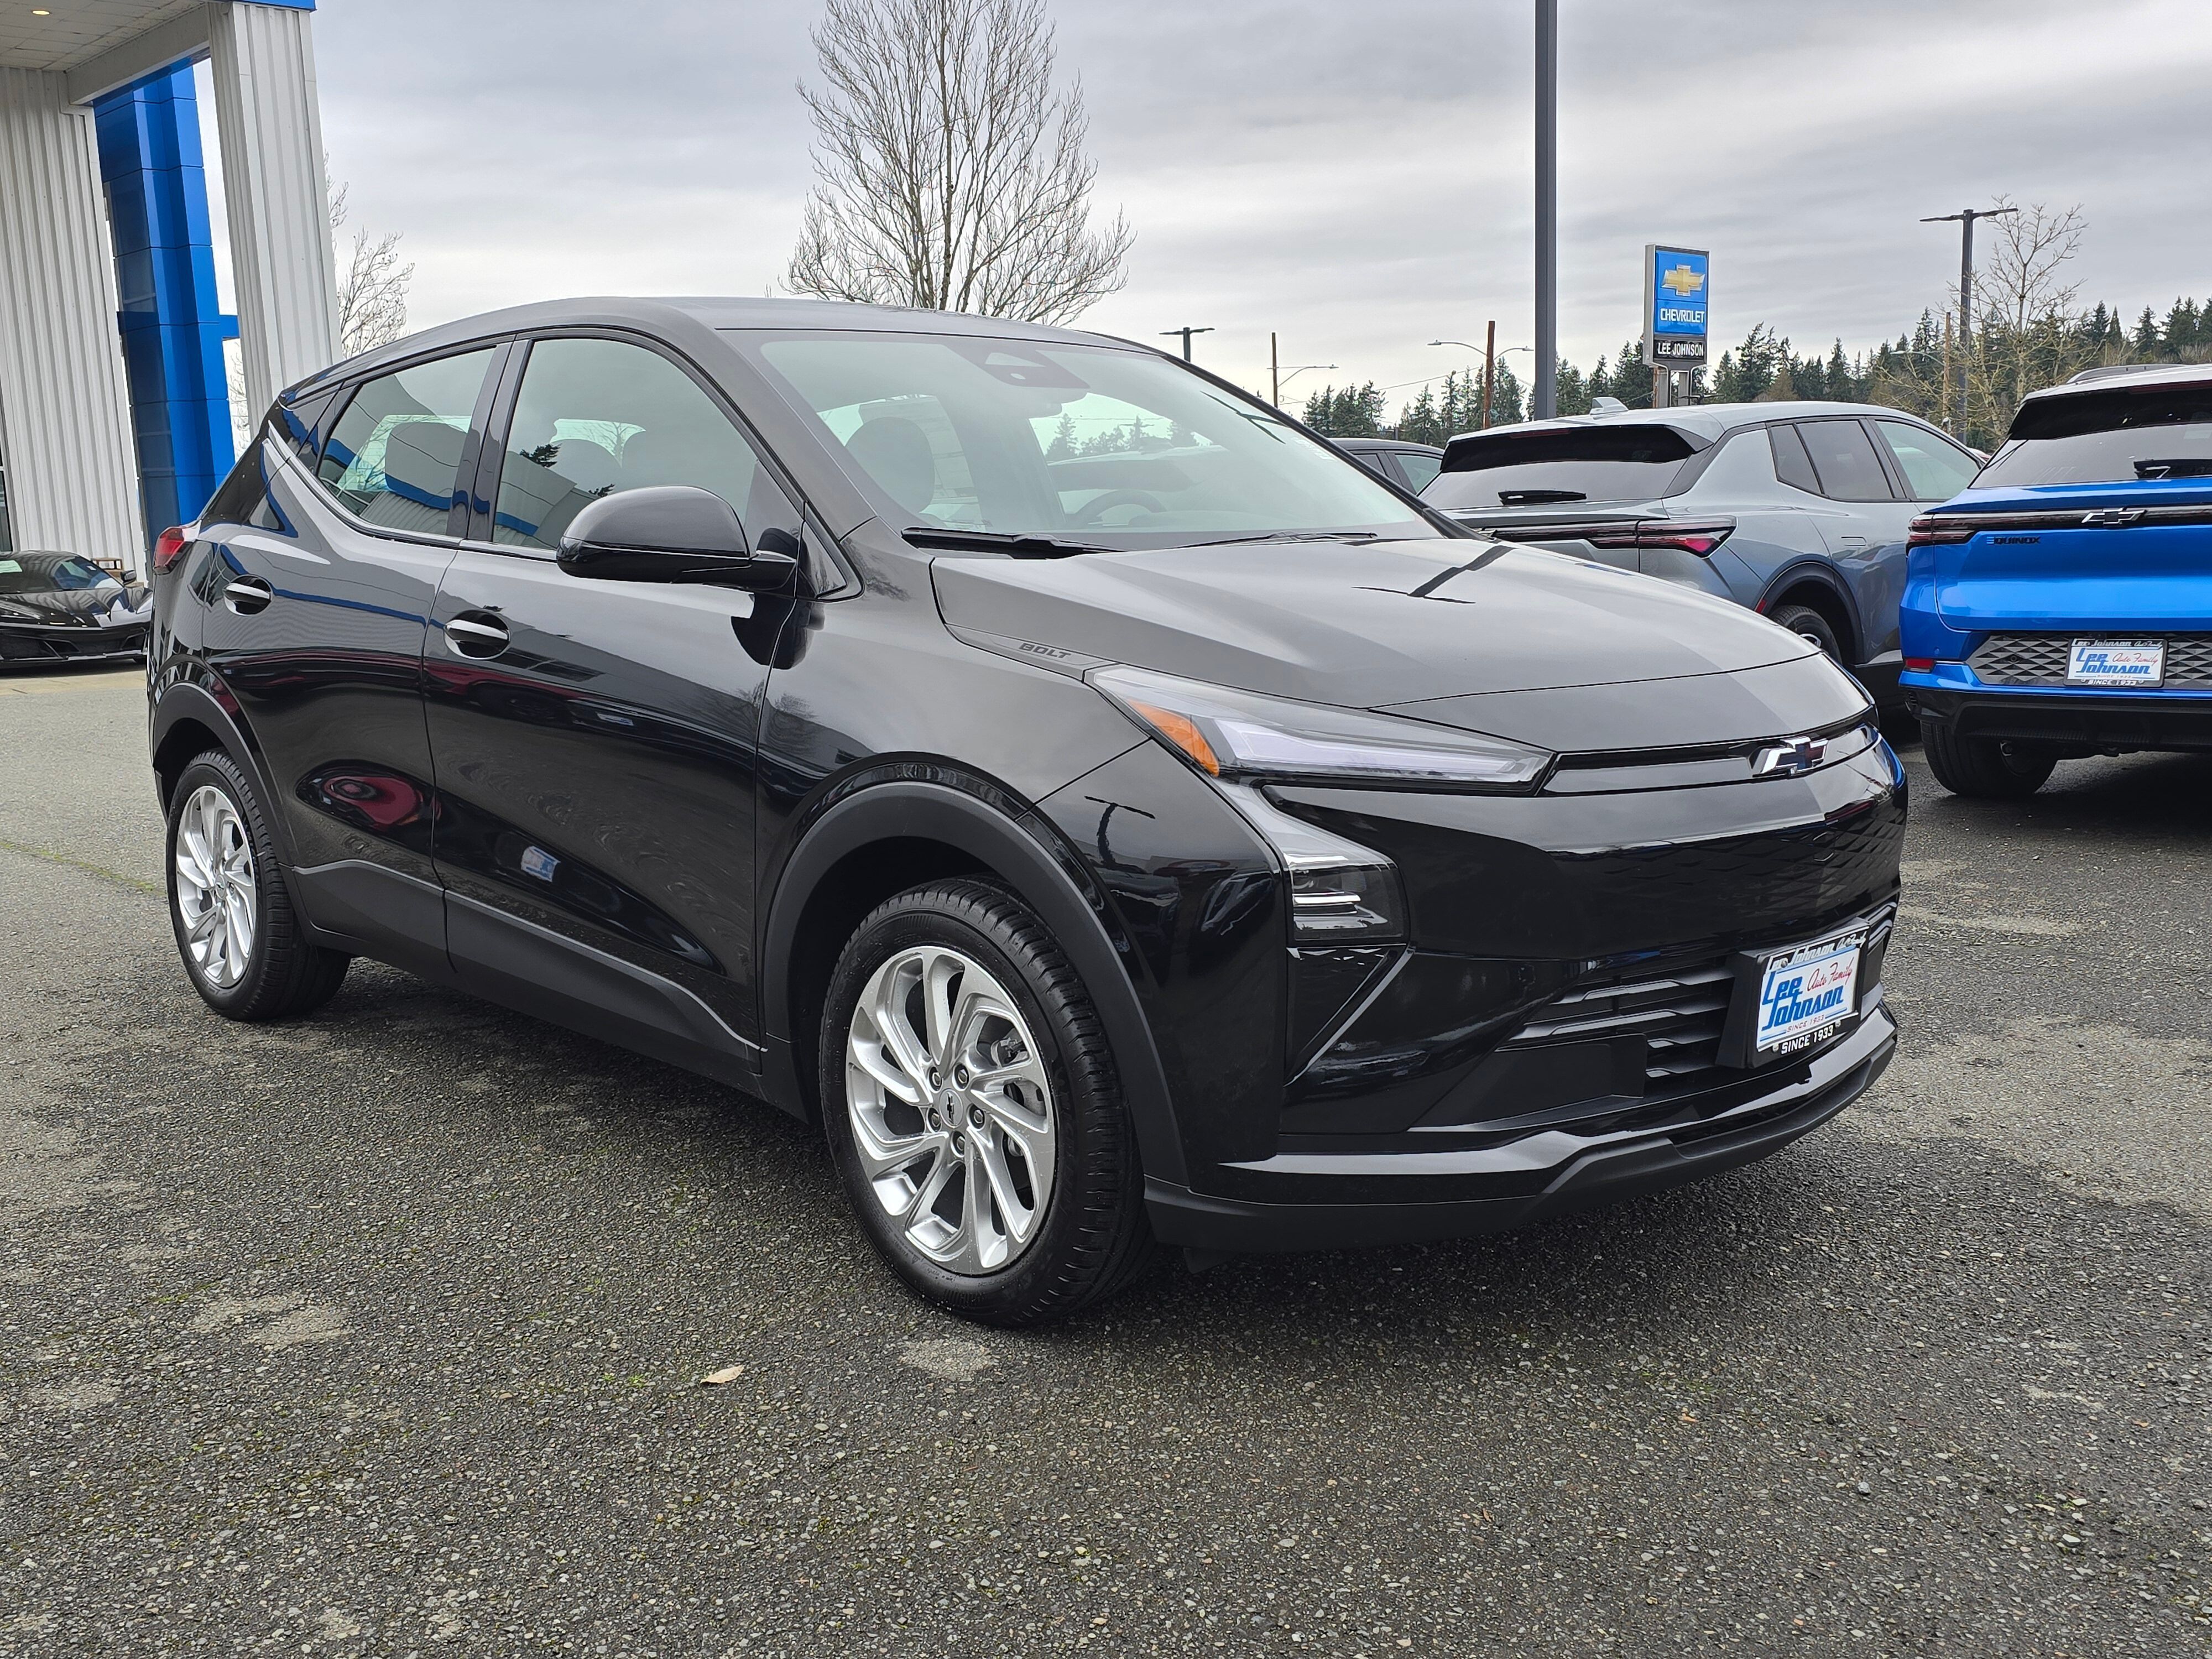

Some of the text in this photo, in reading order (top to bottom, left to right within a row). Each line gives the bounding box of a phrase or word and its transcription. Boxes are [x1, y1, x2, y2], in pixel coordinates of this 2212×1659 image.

[1660, 308, 1705, 324] CHEVROLET
[1658, 342, 1704, 356] LEE JOHNSON
[1986, 536, 2041, 545] EQUINOX
[1019, 643, 1072, 659] BOLT
[2076, 648, 2158, 666] Lee Auto Family
[2076, 660, 2151, 674] Johnson
[1787, 943, 1835, 966] Johnson
[1762, 957, 1854, 1005] Lee Auto Family
[1761, 985, 1844, 1031] Johnson
[1787, 1014, 1824, 1032] SINCE 1933
[1781, 1025, 1834, 1054] SINCE 1933
